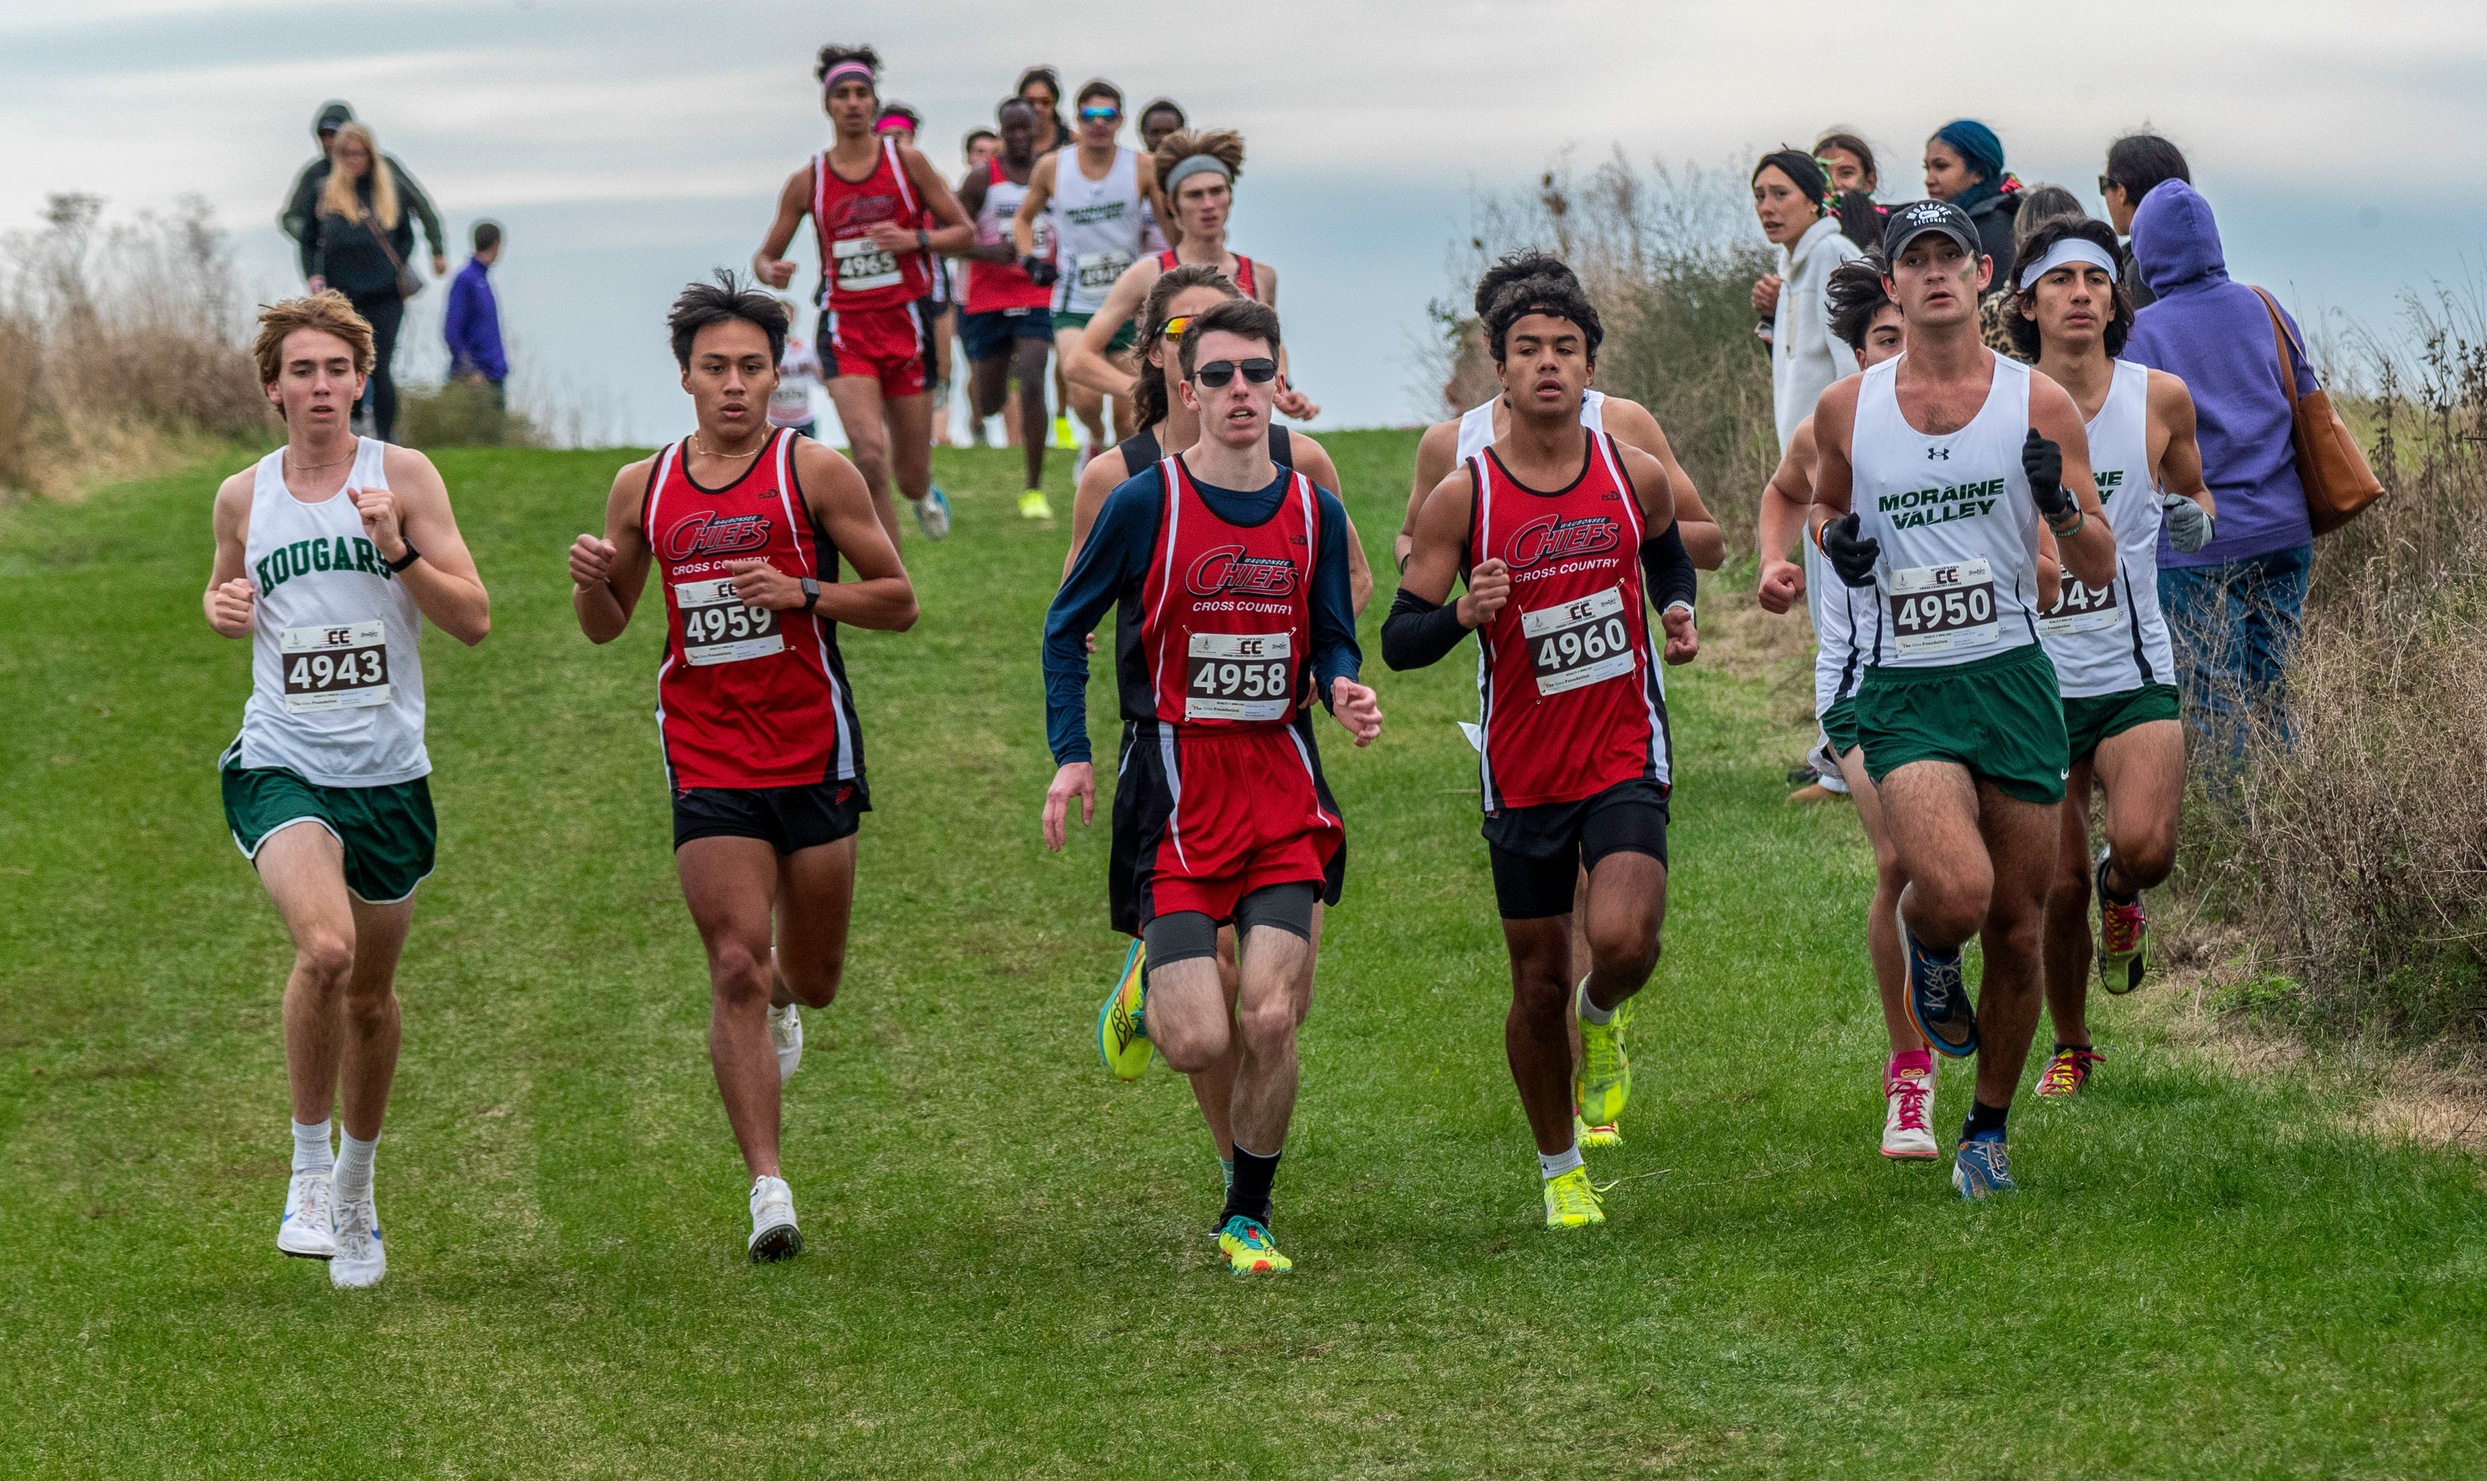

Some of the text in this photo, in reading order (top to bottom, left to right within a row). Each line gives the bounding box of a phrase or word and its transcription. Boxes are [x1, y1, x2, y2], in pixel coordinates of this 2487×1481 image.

[1906, 203, 1952, 219] MORAINE
[1913, 218, 1947, 227] CYCLONES
[1879, 478, 2005, 512] MORAINE
[1891, 499, 1996, 530] VALLEY
[663, 510, 772, 562] CHIEFS
[1504, 513, 1621, 569] CHIEFS
[256, 536, 392, 599] KOUGARS
[672, 562, 710, 576] CROSS
[1185, 544, 1299, 597] CHIEFS
[1515, 559, 1619, 583] CROSS COUNTRY
[1936, 569, 1958, 585] CC
[1193, 602, 1293, 615] CROSS COUNTRY
[1570, 602, 1593, 620] CC
[1898, 588, 1990, 630] 4950
[2039, 580, 2108, 616] 49
[328, 630, 350, 645] CC
[687, 605, 771, 643] 4959
[1241, 640, 1262, 655] CC
[1538, 618, 1626, 670] 4960
[289, 650, 382, 689] 4943
[1193, 662, 1286, 697] 4958
